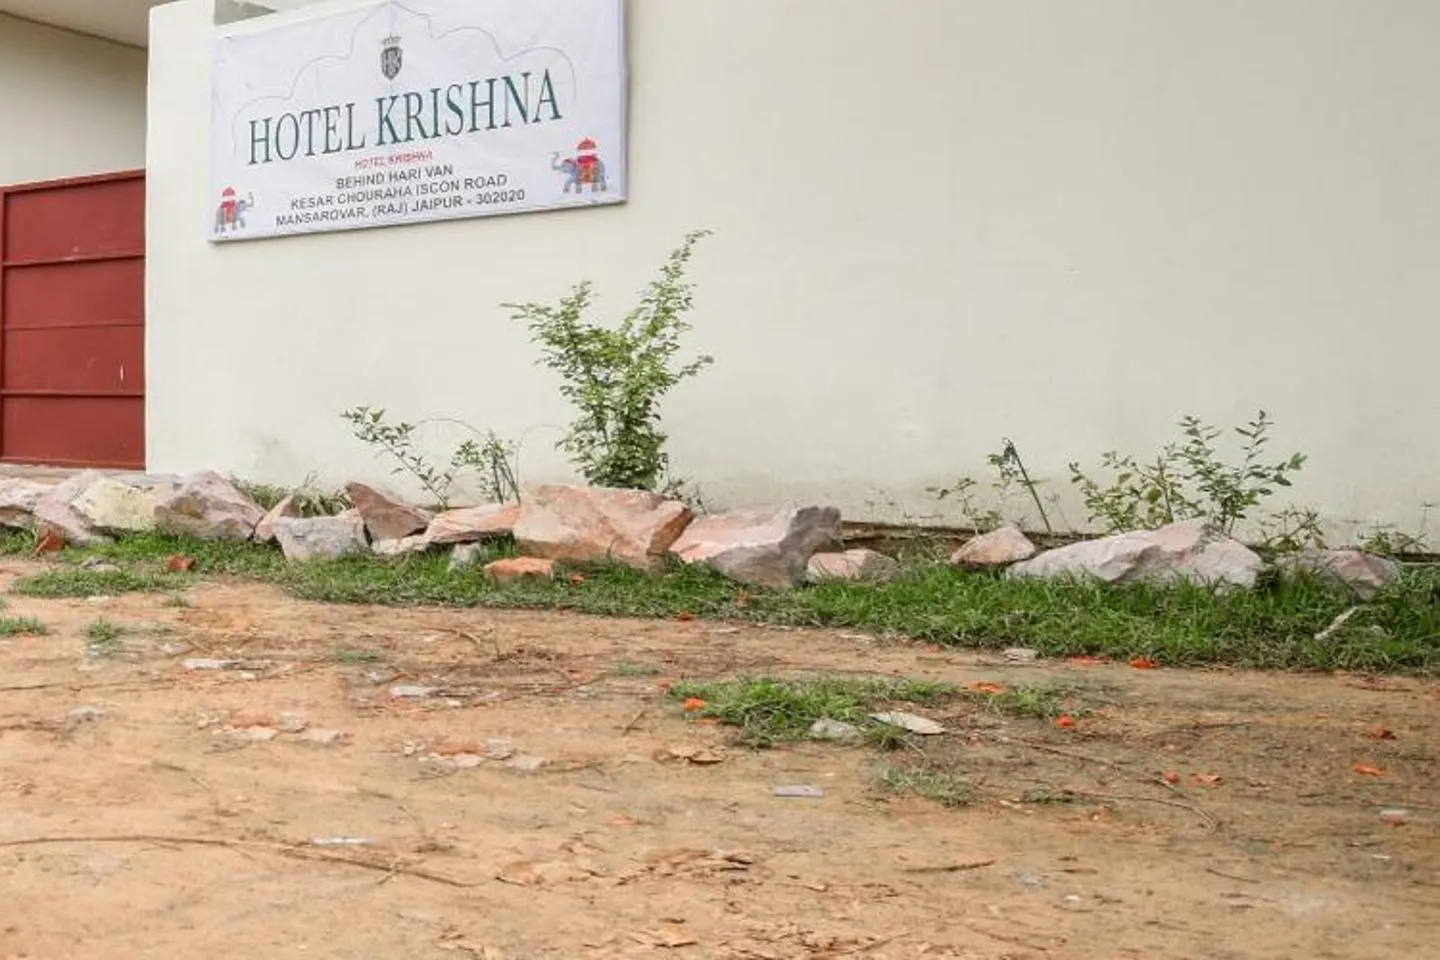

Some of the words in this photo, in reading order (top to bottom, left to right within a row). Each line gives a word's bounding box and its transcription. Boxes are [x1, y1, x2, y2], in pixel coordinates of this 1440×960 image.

[248, 102, 365, 164] HOTEL
[375, 68, 563, 146] KRISHNA
[335, 172, 385, 190] BEHIND
[389, 166, 421, 183] HARI
[424, 163, 453, 179] VAN
[354, 156, 385, 169] HOTEL
[291, 194, 334, 210] KESAR
[337, 184, 413, 204] CHOURAHA
[416, 180, 460, 197] ISCON
[464, 173, 508, 190] ROAD
[372, 200, 408, 218] (RAJ)
[412, 194, 463, 213] JAIPUR
[475, 188, 525, 206] 302020
